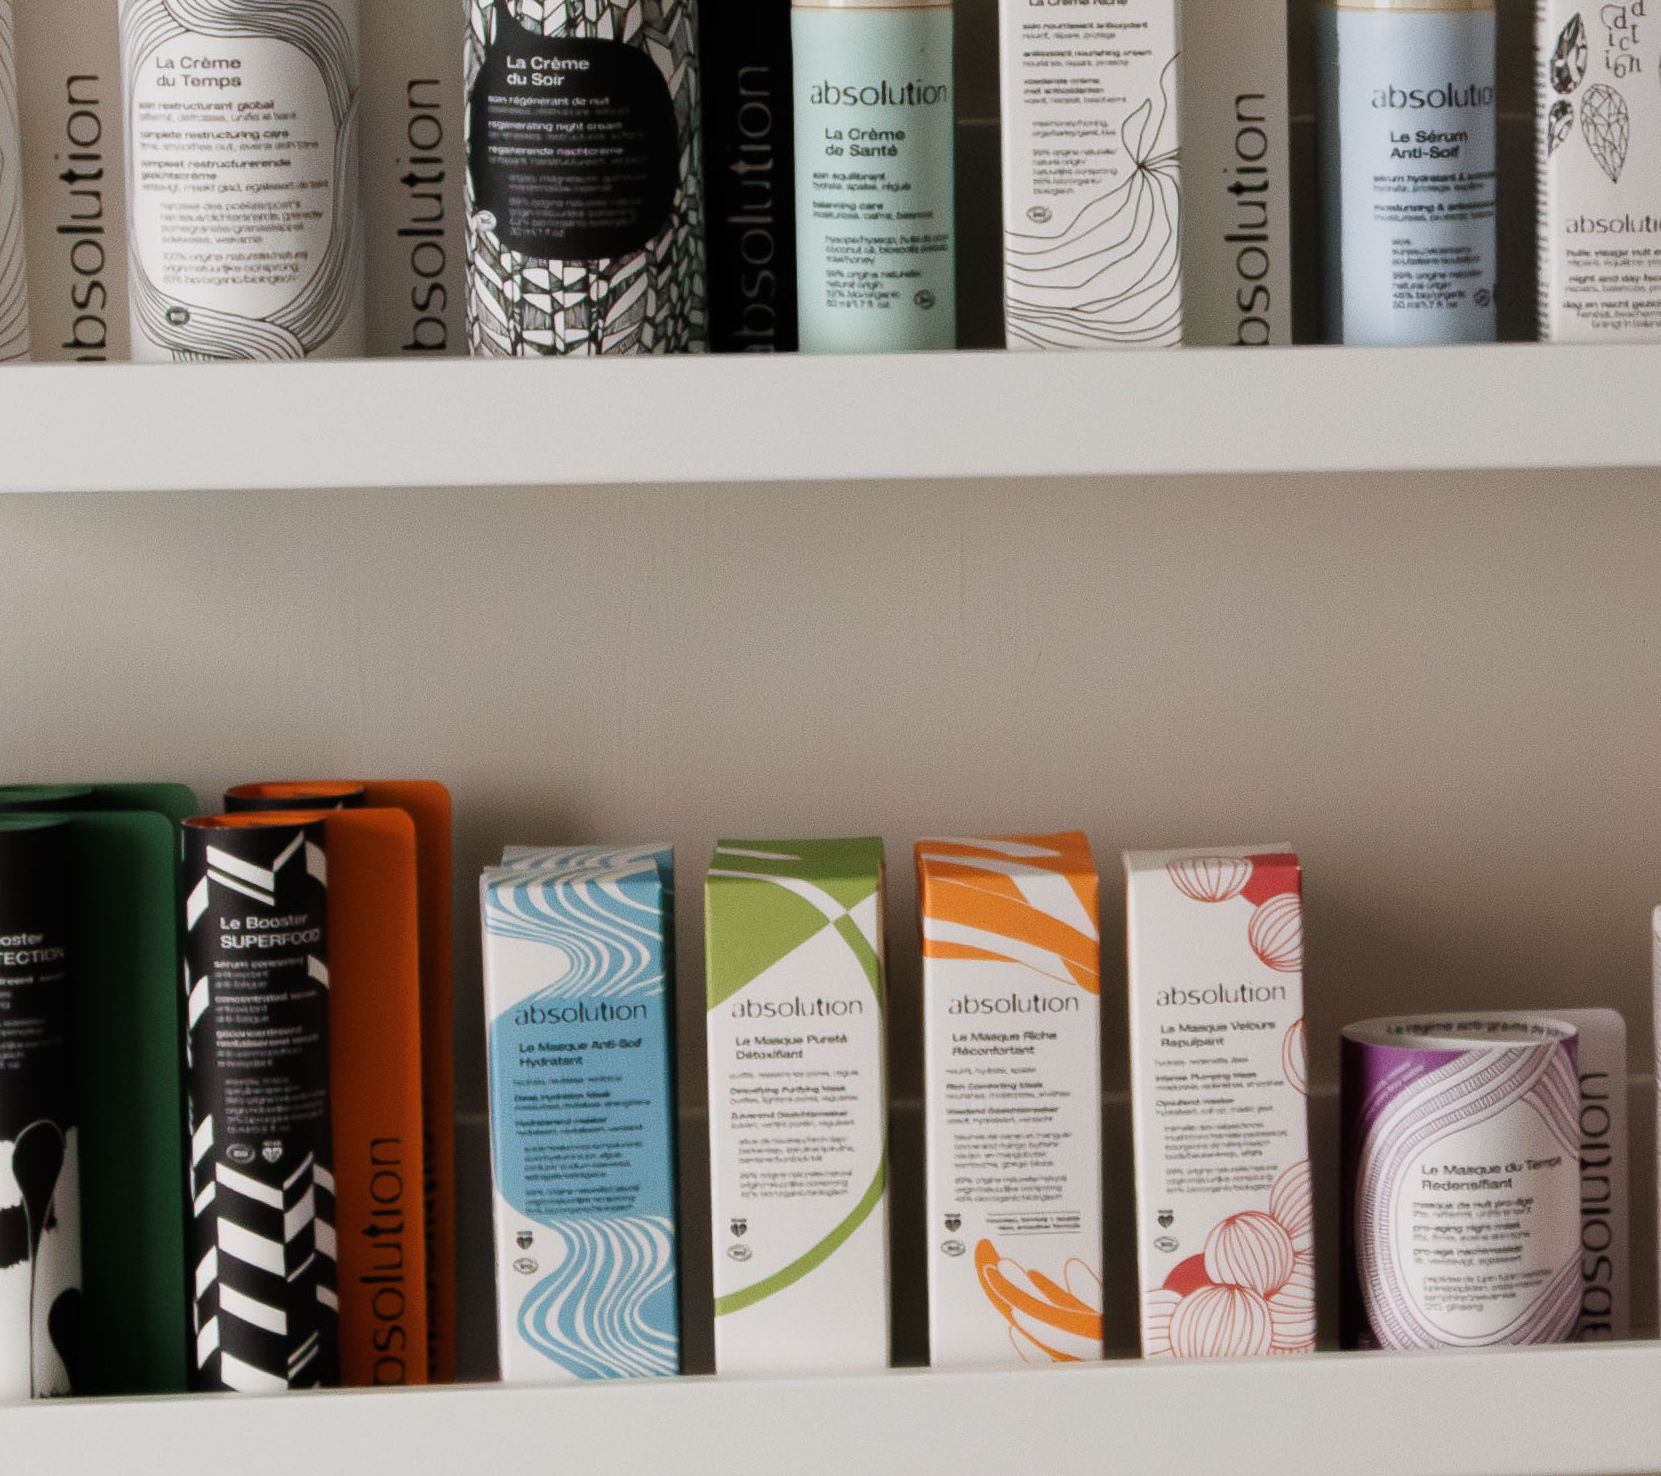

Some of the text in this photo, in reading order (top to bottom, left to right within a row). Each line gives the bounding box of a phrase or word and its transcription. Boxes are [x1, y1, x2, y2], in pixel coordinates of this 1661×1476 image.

[156, 56, 242, 69] La Crème
[506, 56, 590, 70] La Crème
[156, 75, 243, 90] du Temps
[506, 73, 565, 86] du Soir
[810, 79, 947, 106] absolution
[1371, 83, 1495, 108] absolutio
[825, 128, 906, 141] La Crème
[1390, 130, 1468, 144] Le Sérum
[825, 144, 898, 157] de Santé
[1390, 146, 1460, 159] Anti-Soif
[54, 74, 108, 362] bsolution
[398, 79, 448, 351] bsolution
[1225, 94, 1270, 345] bsolution
[220, 914, 309, 930] Le Booster
[220, 928, 321, 949] SUPERFOOD
[1156, 982, 1286, 1007] absolution
[731, 996, 863, 1019] absolution
[948, 993, 1079, 1015] absolution
[514, 1001, 647, 1025] absolution
[1161, 1021, 1276, 1035] Le Masque Velours
[735, 1034, 847, 1047] Le Masque Pureté
[952, 1031, 1057, 1043] Le Masque Riche
[1161, 1037, 1224, 1049] Repulpant
[519, 1037, 643, 1053] Le Masque Anti-Soif
[952, 1045, 1035, 1056] Réconfortant
[736, 1049, 804, 1060] Détoxifiant
[519, 1056, 583, 1068] Hydratant
[1422, 1165, 1438, 1175] Le
[1443, 1164, 1501, 1175] Masque
[1504, 1162, 1522, 1173] du
